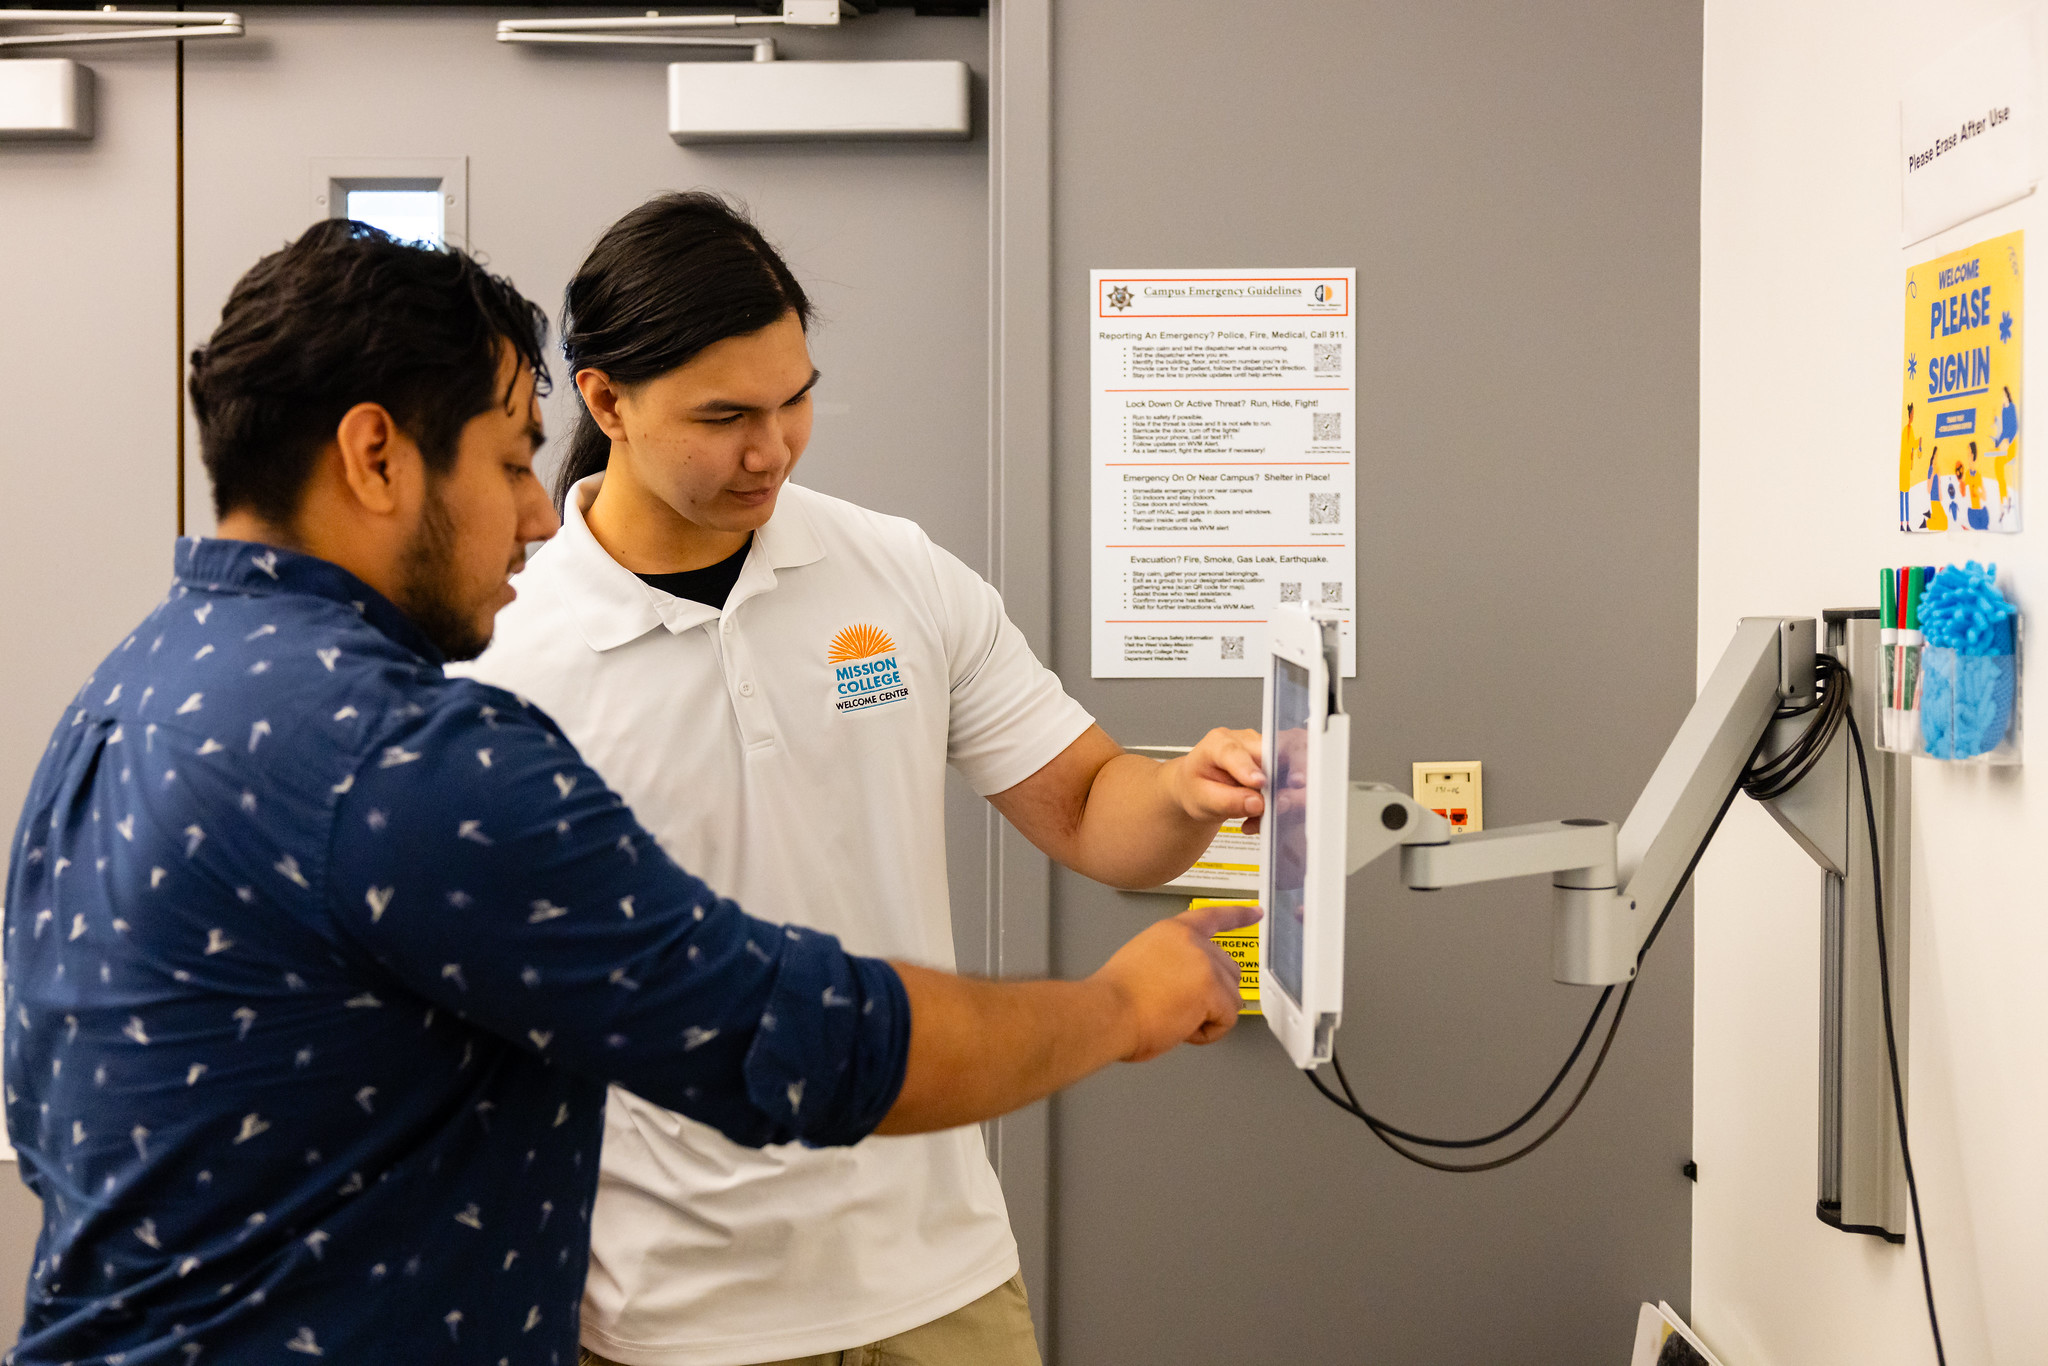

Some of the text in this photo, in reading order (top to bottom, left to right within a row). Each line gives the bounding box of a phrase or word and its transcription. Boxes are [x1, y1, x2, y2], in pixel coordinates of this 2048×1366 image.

[1909, 106, 2010, 173] Please Erase After Use
[1939, 258, 1980, 290] WELCOME
[1144, 286, 1302, 298] Campus Emergency Guidelines
[1930, 286, 1991, 339] PLEASE
[1099, 332, 1142, 340] Reporting
[1160, 332, 1214, 340] Emergency?
[1928, 346, 1990, 395] SIGN IN
[1295, 400, 1318, 408] Fight!
[1123, 474, 1170, 483] Emergency
[836, 657, 897, 681] MISSION
[838, 671, 900, 694] COLLEGE
[836, 688, 908, 710] WELCOME CENTER
